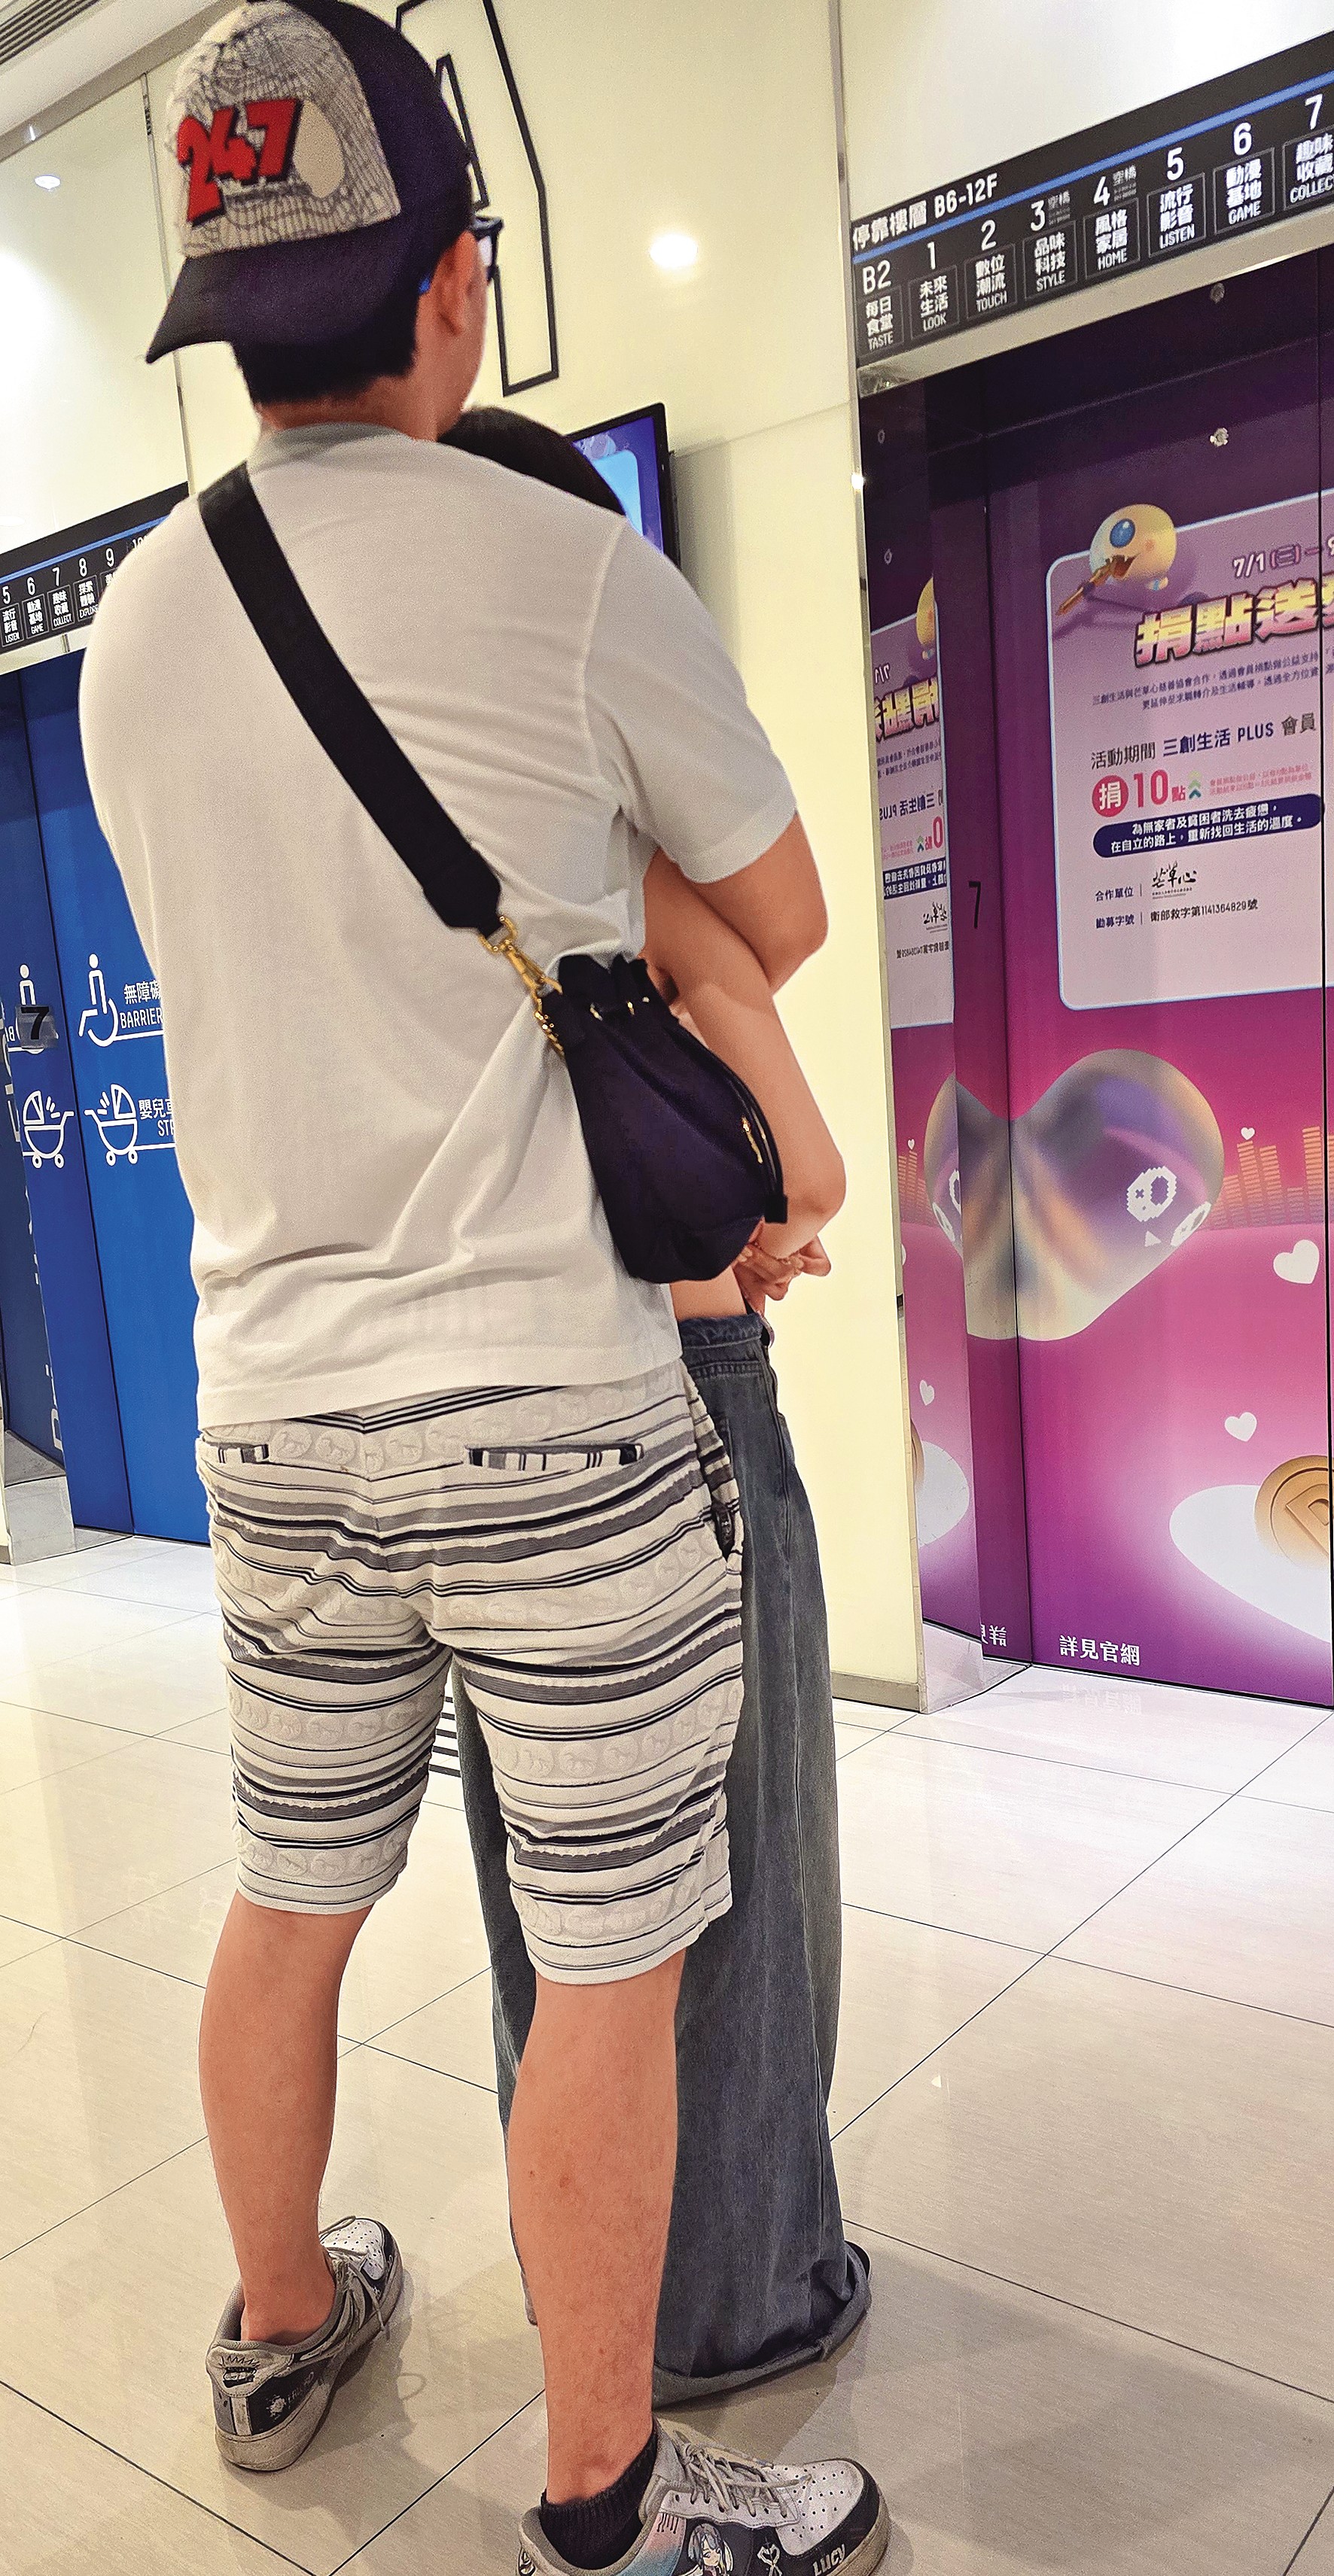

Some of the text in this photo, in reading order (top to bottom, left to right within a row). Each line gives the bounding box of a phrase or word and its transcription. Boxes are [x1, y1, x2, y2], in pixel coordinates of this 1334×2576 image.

[1305, 93, 1323, 130] 7
[1233, 122, 1252, 156] 6
[177, 96, 301, 227] 247
[1167, 147, 1184, 181] 5
[1226, 158, 1262, 189] 動漫
[1296, 153, 1333, 183] 收藏
[1093, 175, 1110, 206] 4
[1160, 183, 1194, 213] 流行
[1226, 180, 1262, 208] 基地
[1290, 173, 1334, 203] COLLEC
[853, 173, 997, 251] 停靠樓層 B6-12F
[1030, 199, 1046, 231] 3
[1095, 208, 1128, 236] 風格
[1160, 203, 1194, 232] 影音
[1228, 200, 1261, 225] GAME
[981, 219, 997, 251] 2
[1034, 232, 1066, 259] 品味
[1095, 227, 1128, 254] 家居
[1159, 224, 1195, 249] LISTEN
[927, 242, 936, 269] 1
[975, 254, 1005, 279] 數位
[1035, 251, 1066, 276] 科技
[1097, 248, 1128, 271] HOME
[863, 260, 891, 295] B2
[919, 275, 948, 300] 未來
[976, 272, 1007, 297] 潮流
[1036, 270, 1065, 292] STYLE
[866, 296, 891, 318] 每日
[920, 294, 949, 318] 生活
[976, 290, 1007, 312] TOUCH
[866, 314, 894, 337] 食堂
[923, 314, 946, 332] LOOK
[868, 332, 894, 351] TASTE
[78, 558, 87, 577] 8
[105, 548, 115, 567] 9
[1234, 553, 1264, 577] 7/1
[26, 576, 35, 596] 6
[52, 567, 60, 587] 7
[2, 585, 11, 604] 5
[1135, 570, 1334, 668] 捐點送
[1092, 713, 1317, 769] 活動期間 三創生活 PLUS 會員
[1099, 783, 1121, 811] 捐
[1095, 887, 1134, 902] 合作單位
[20, 1006, 50, 1040] 7
[1059, 1635, 1140, 1666] 詳見官網
[813, 2544, 845, 2576] LUCY
